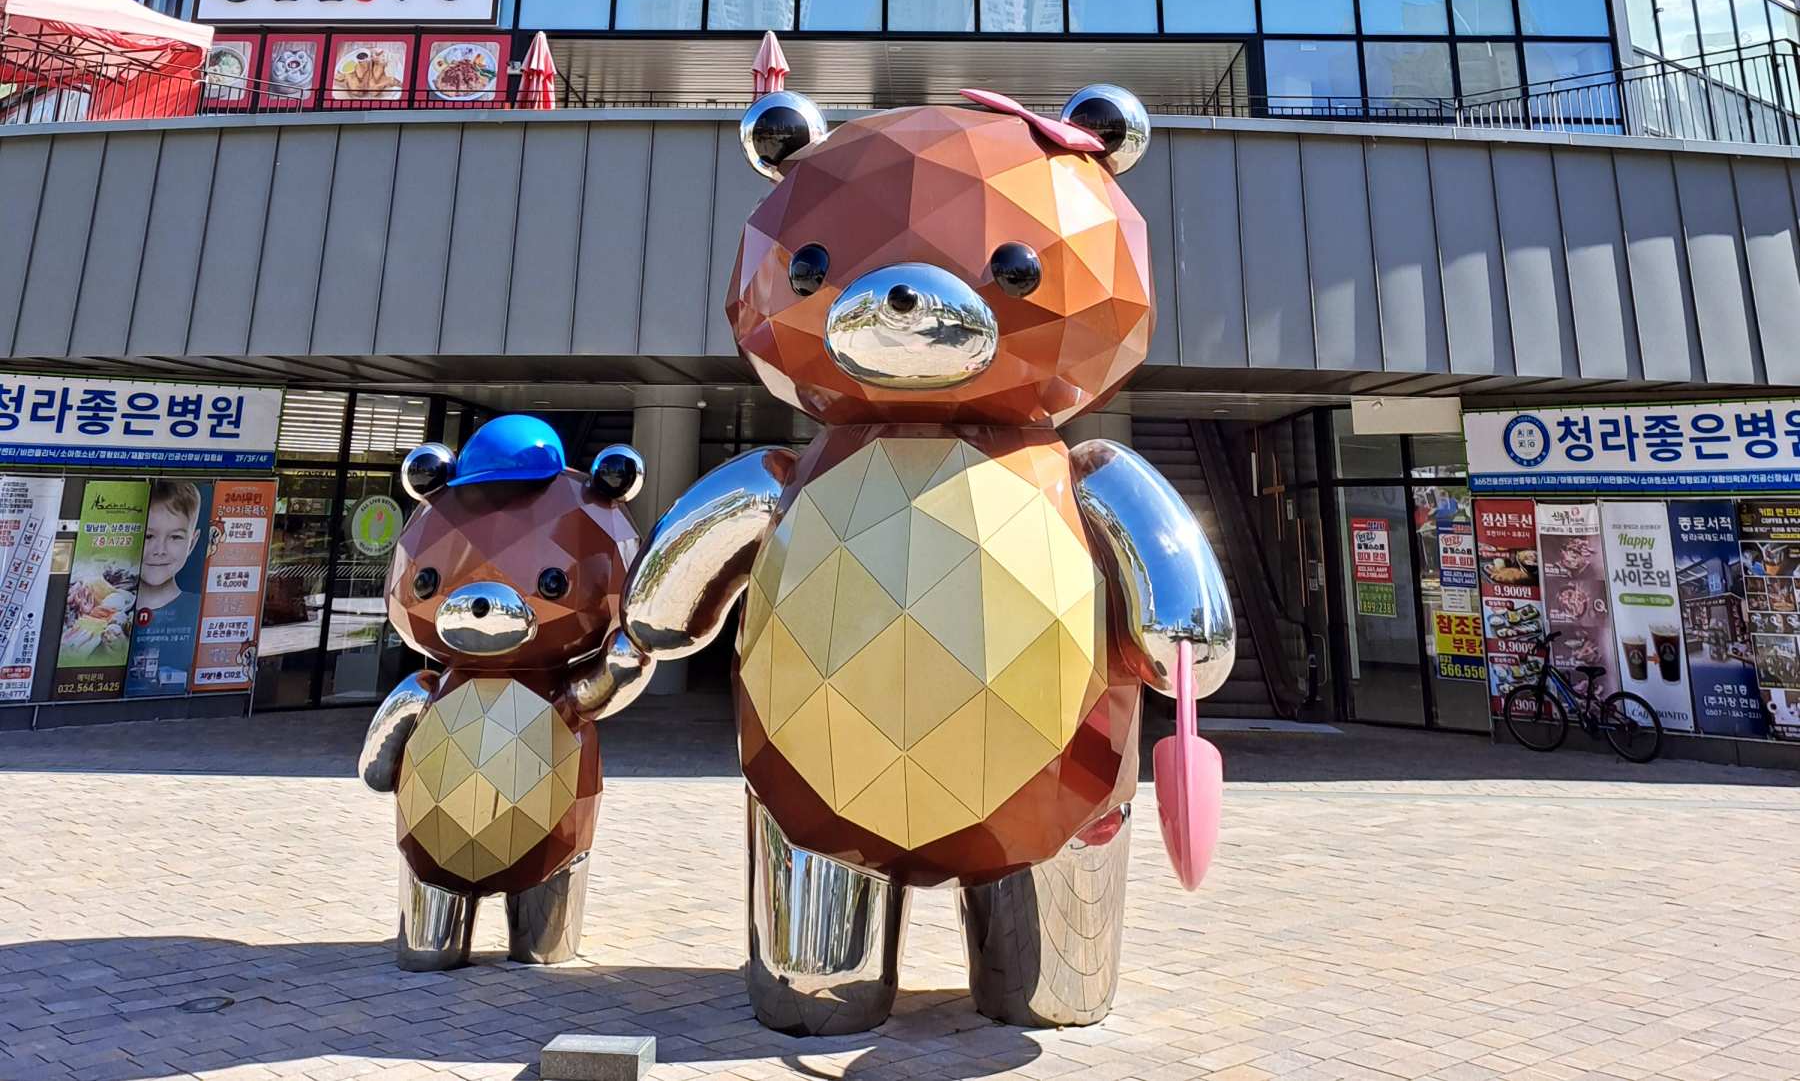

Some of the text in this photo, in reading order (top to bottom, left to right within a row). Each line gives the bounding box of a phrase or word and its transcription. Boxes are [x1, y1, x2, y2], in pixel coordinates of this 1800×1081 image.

[1481, 512, 1533, 529] 점심특선
[1678, 516, 1732, 531] 종로서적
[1617, 533, 1655, 550] Happy
[1625, 552, 1653, 569] 모닝
[1613, 569, 1671, 587] 사이즈업
